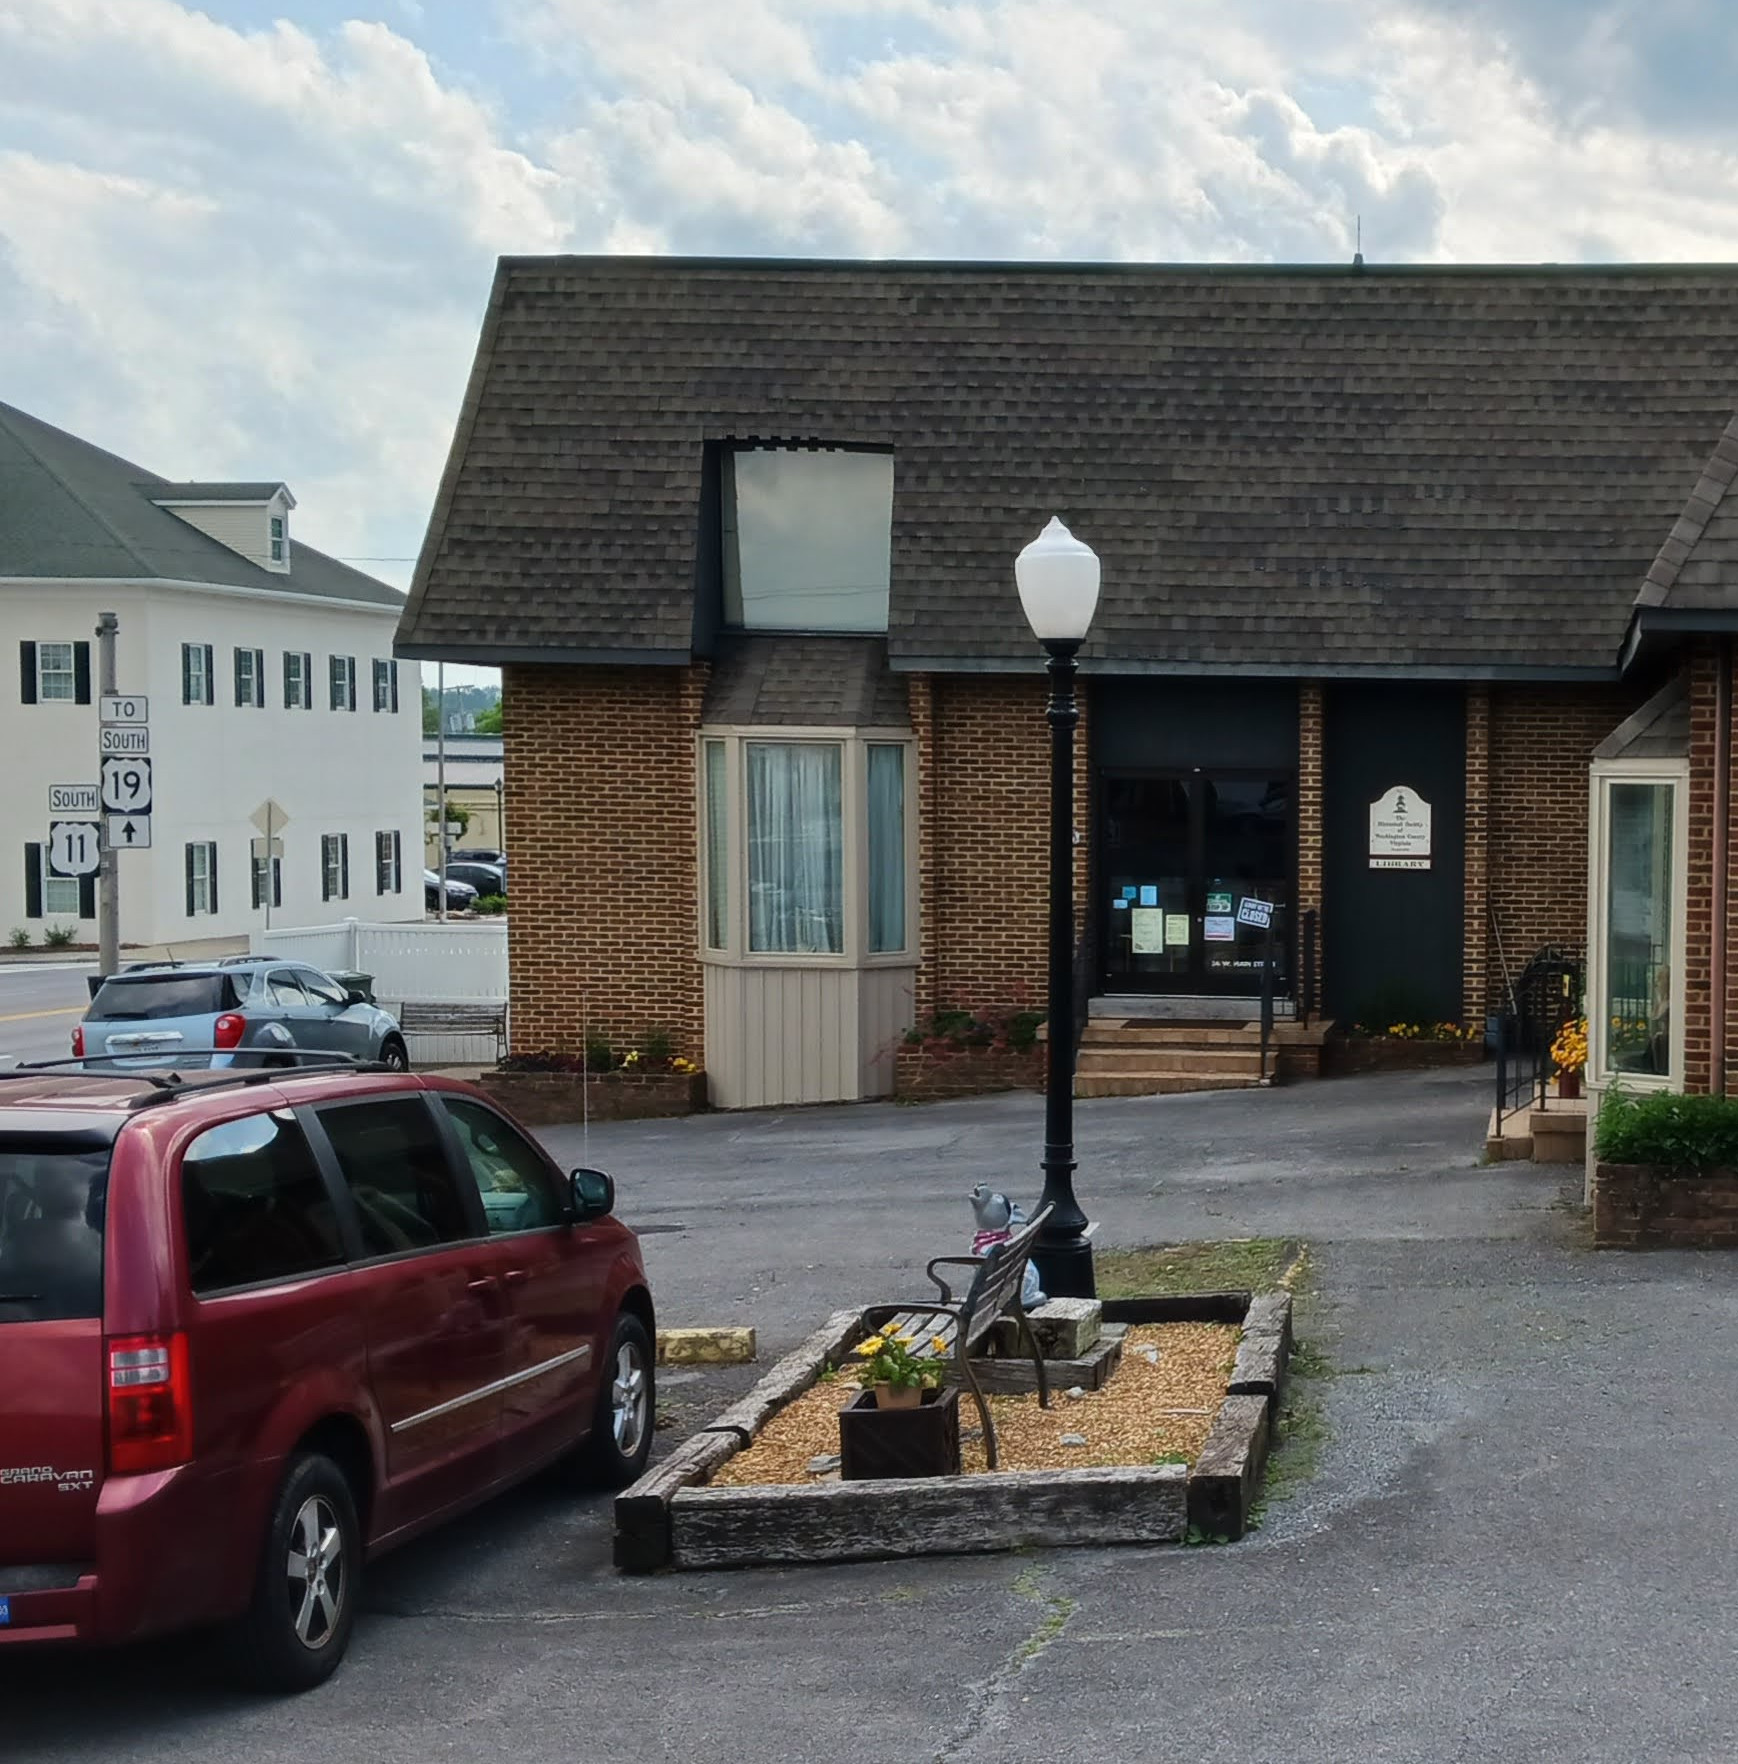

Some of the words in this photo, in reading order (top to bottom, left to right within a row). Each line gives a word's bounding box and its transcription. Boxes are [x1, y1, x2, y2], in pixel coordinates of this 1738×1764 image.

[112, 702, 135, 717] TO
[103, 731, 145, 749] SOUTH
[112, 771, 140, 800] 19
[52, 790, 95, 807] SOUTH
[65, 834, 85, 863] 11
[0, 1469, 94, 1484] CARAVAN
[58, 1481, 94, 1491] SXT
